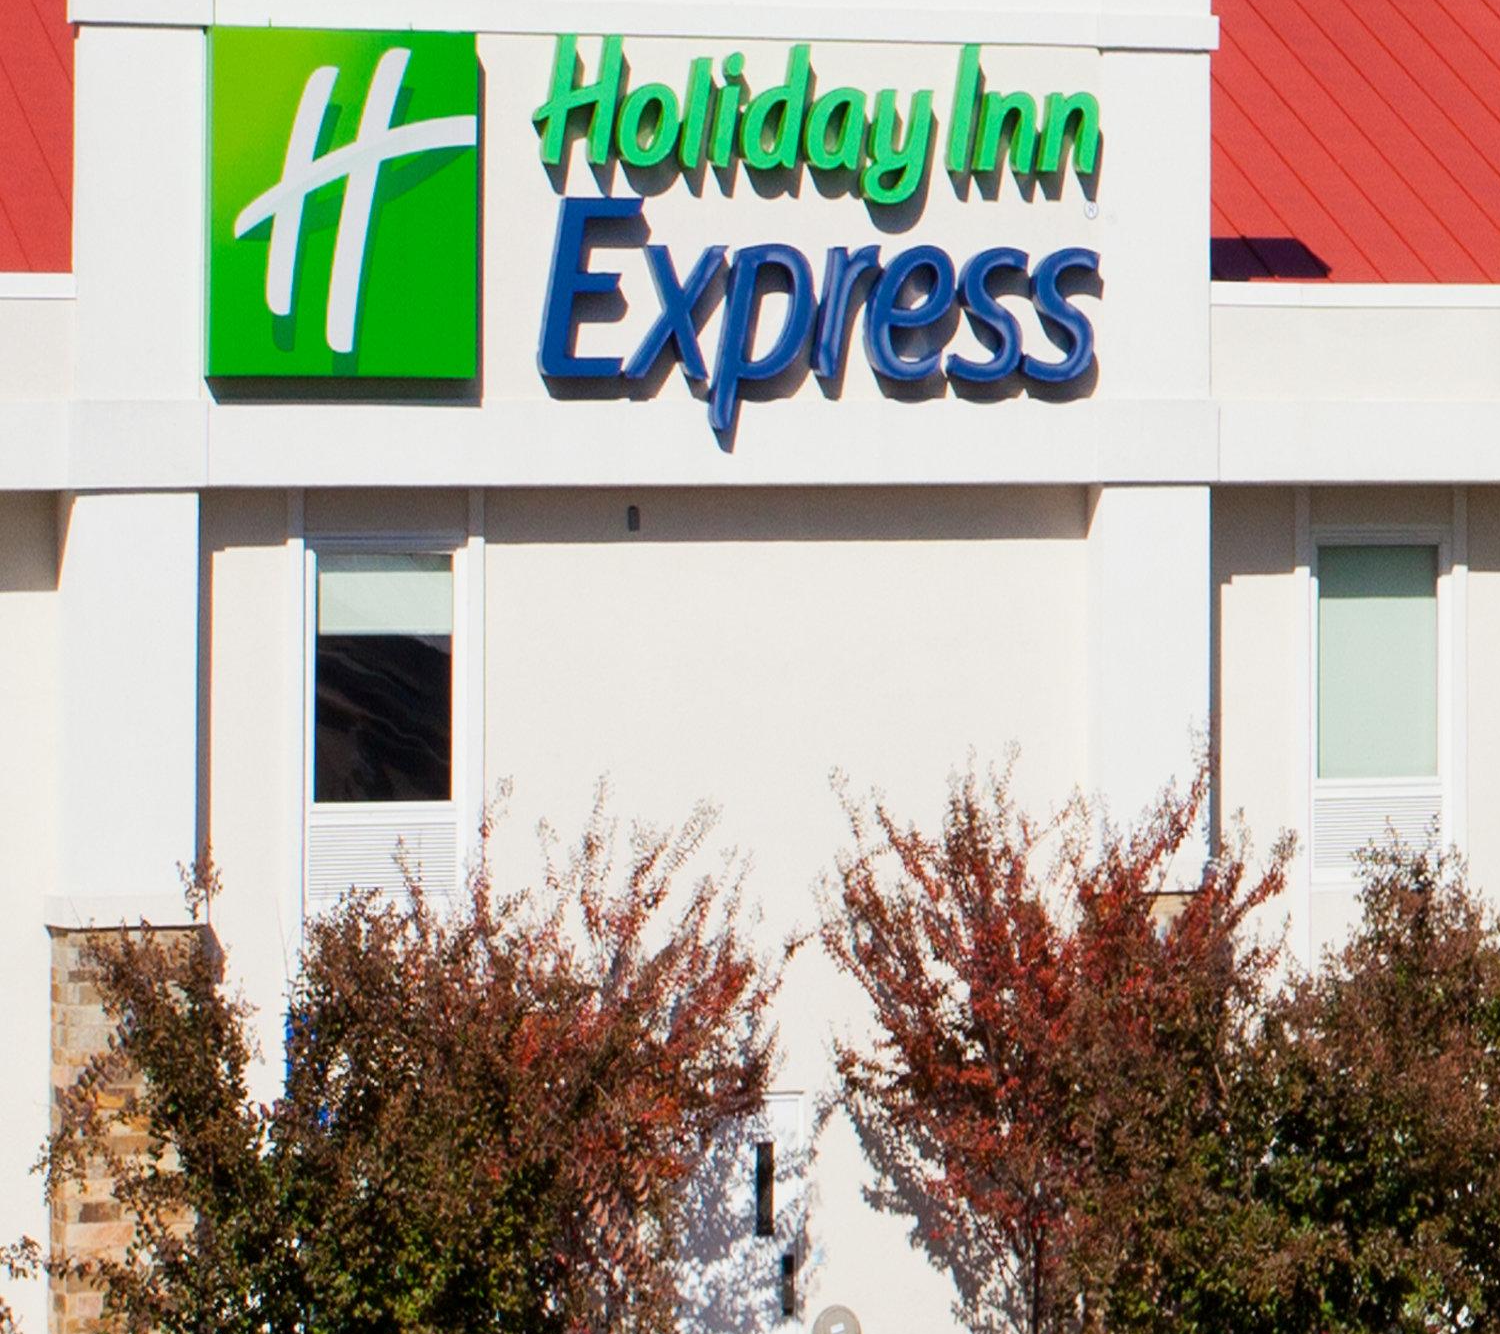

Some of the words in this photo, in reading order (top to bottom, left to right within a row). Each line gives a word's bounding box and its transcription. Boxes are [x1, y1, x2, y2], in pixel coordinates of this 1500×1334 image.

[532, 33, 934, 205] Holiday
[944, 42, 1100, 174] Inn
[536, 196, 1102, 431] Express
